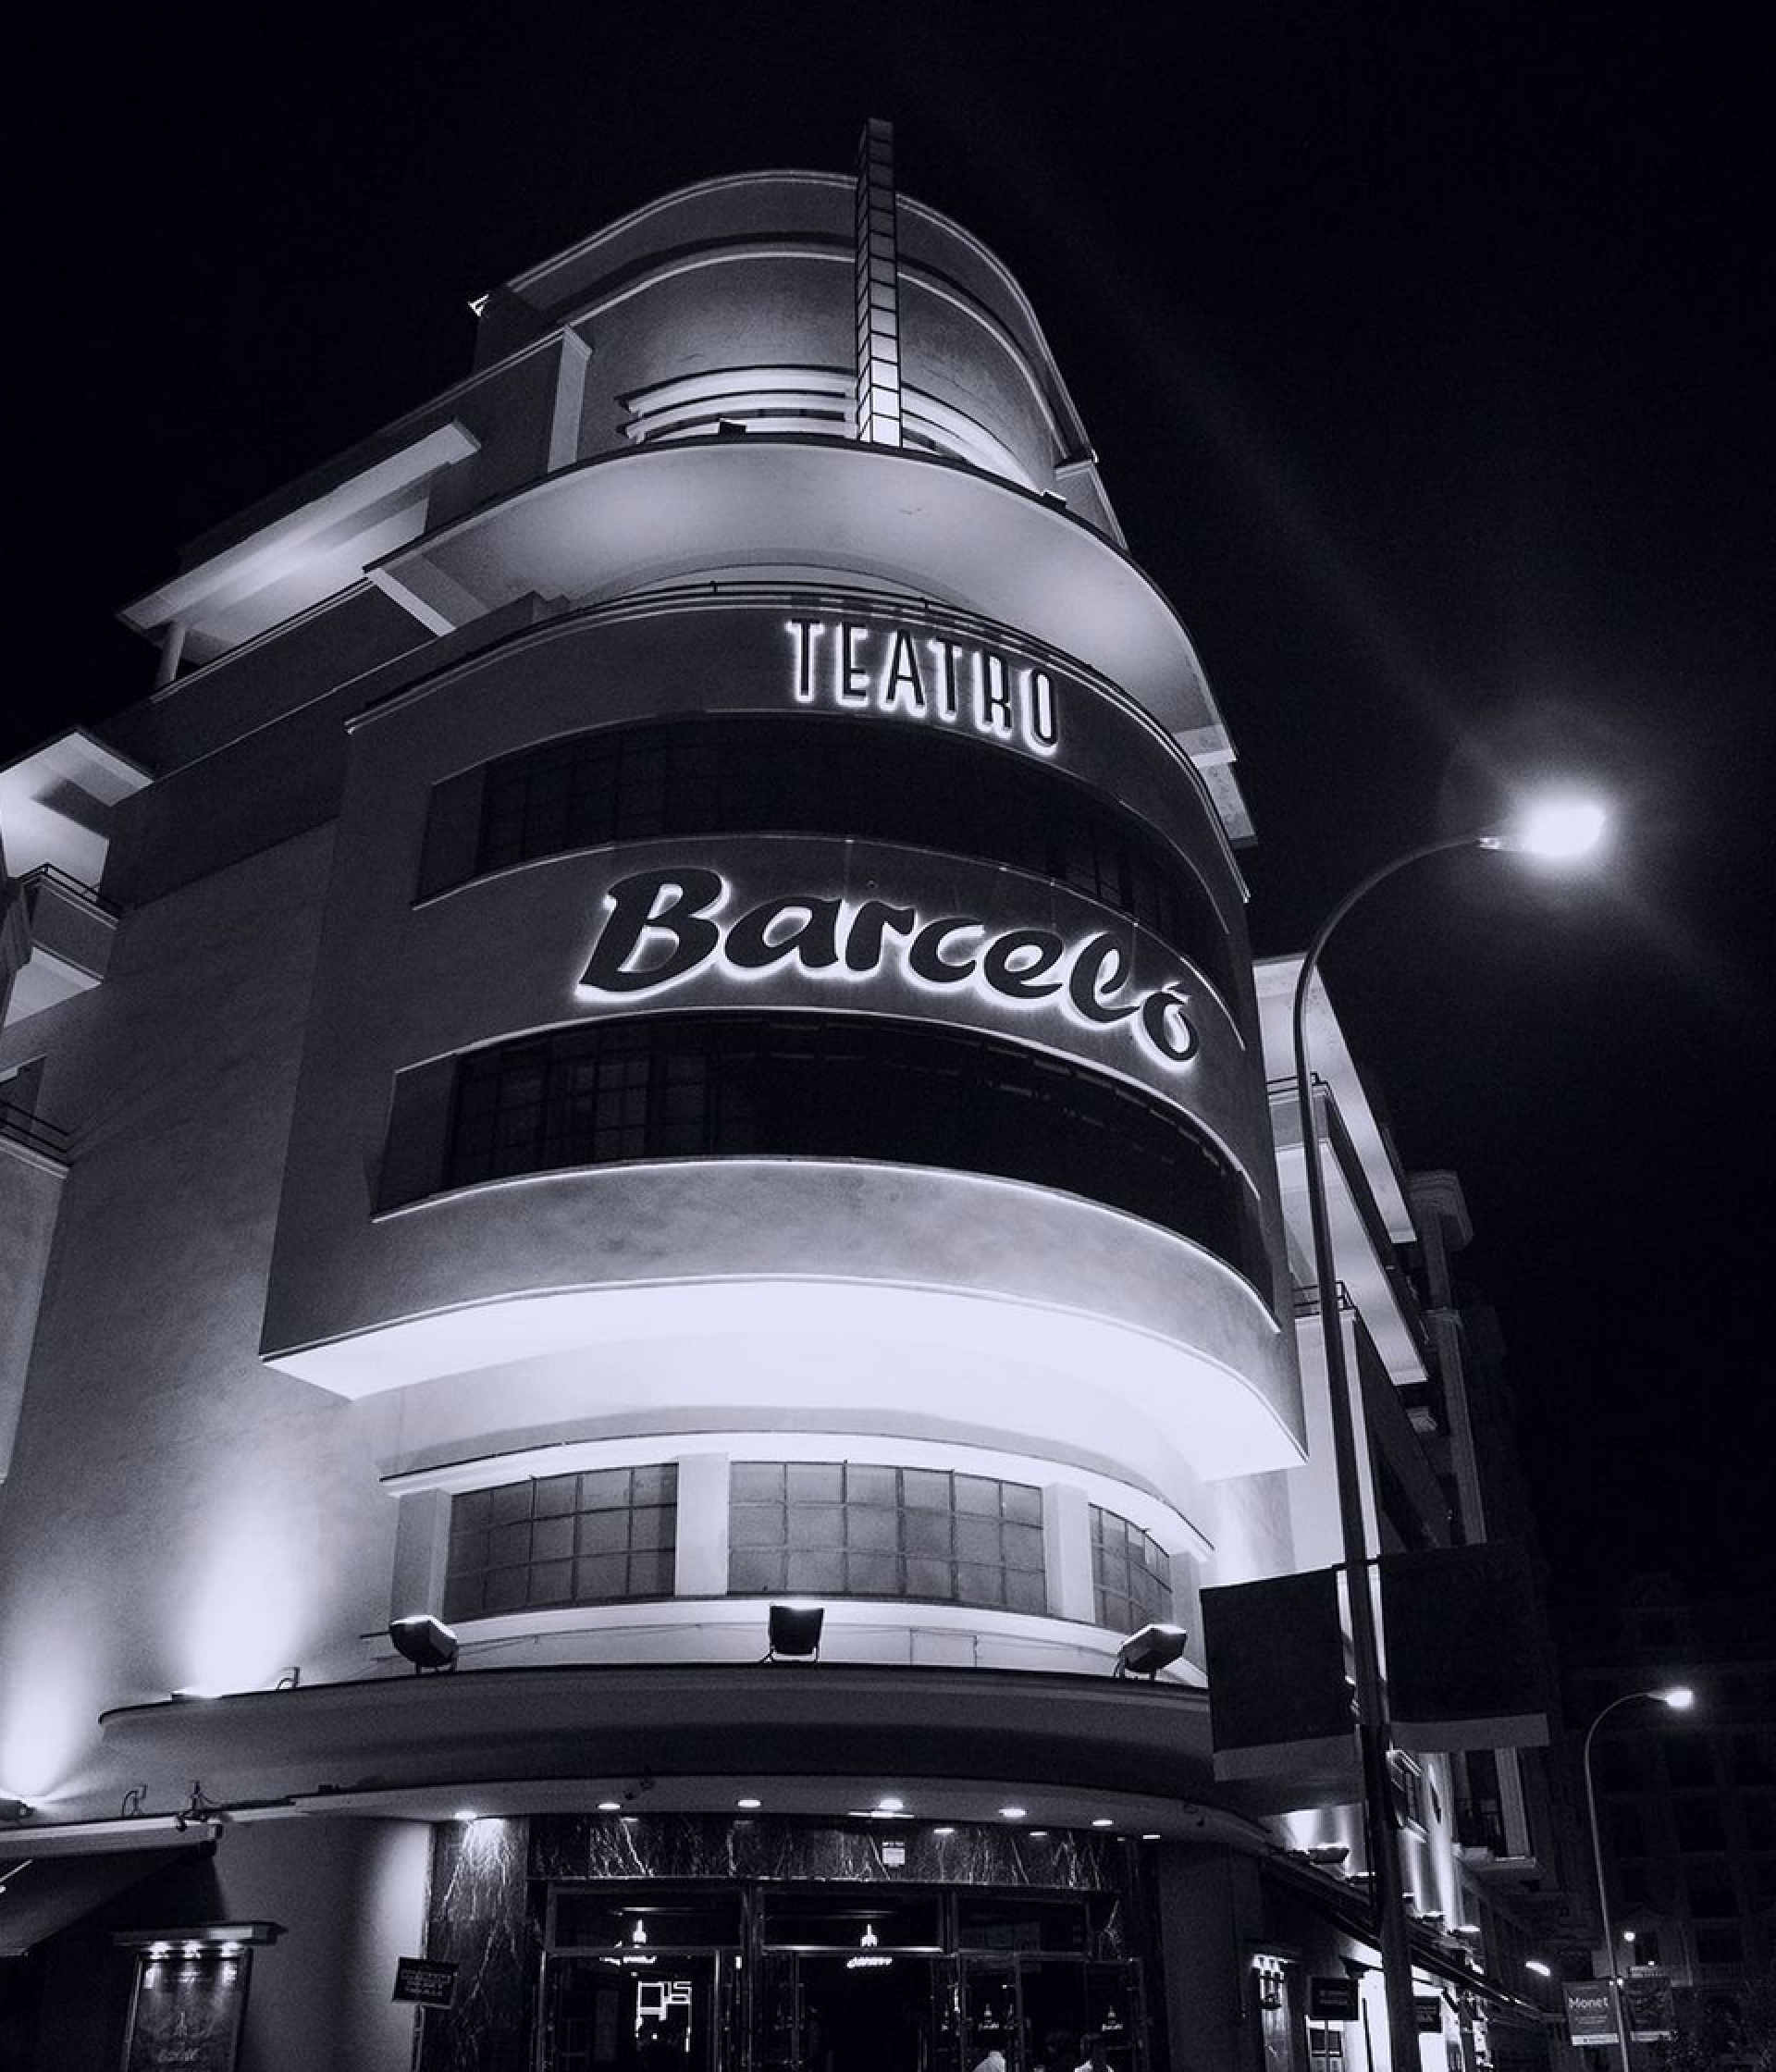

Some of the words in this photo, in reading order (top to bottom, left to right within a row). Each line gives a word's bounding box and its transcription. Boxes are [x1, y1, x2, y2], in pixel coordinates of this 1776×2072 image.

[786, 618, 1058, 753] TEATRO
[577, 867, 1200, 1067] Barceló
[1568, 1996, 1609, 2009] Monet
